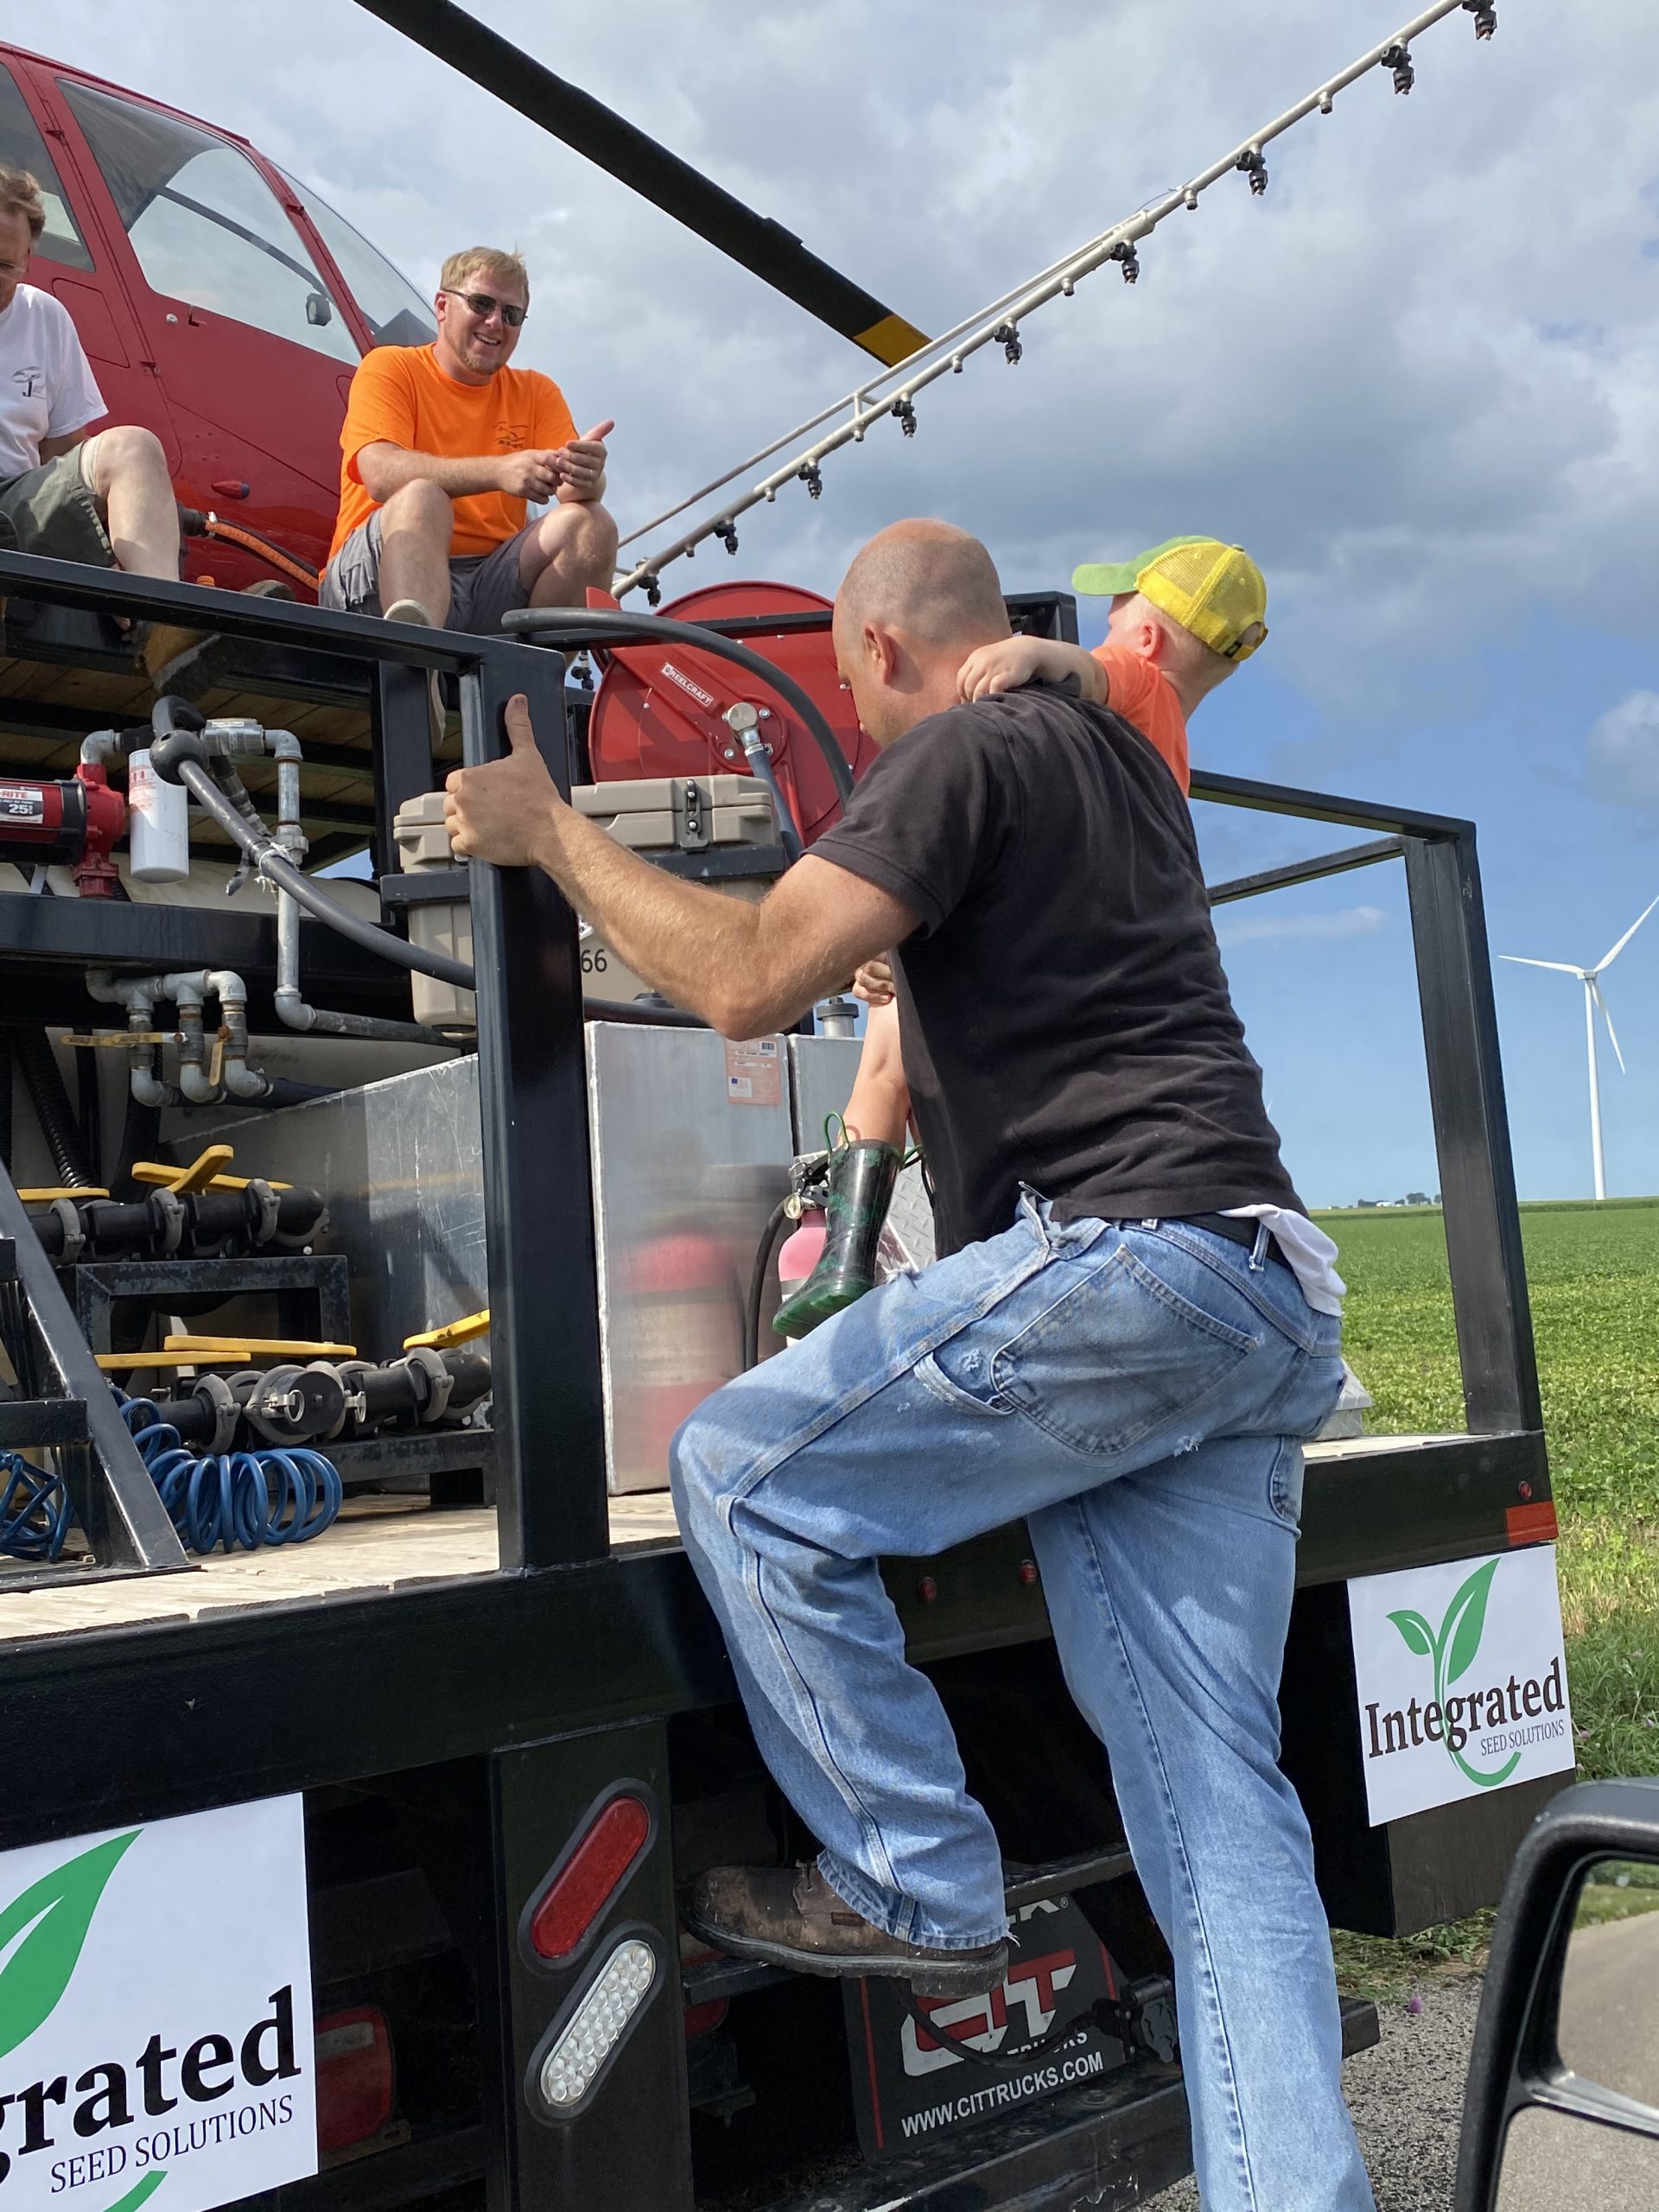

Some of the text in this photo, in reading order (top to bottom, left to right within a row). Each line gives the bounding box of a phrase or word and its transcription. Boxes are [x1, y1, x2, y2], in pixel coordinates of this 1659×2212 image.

[669, 669, 710, 703] REELCRAFT
[9, 804, 29, 815] 25
[581, 949, 607, 974] 66
[1365, 1656, 1565, 1758] Integrated
[1481, 1719, 1565, 1756] SEED SOLUTIONS
[0, 1984, 302, 2184] rated
[901, 2051, 1104, 2138] WWW.CITTRUCKS.COM
[51, 2094, 293, 2193] SEED SOLUTIONS
